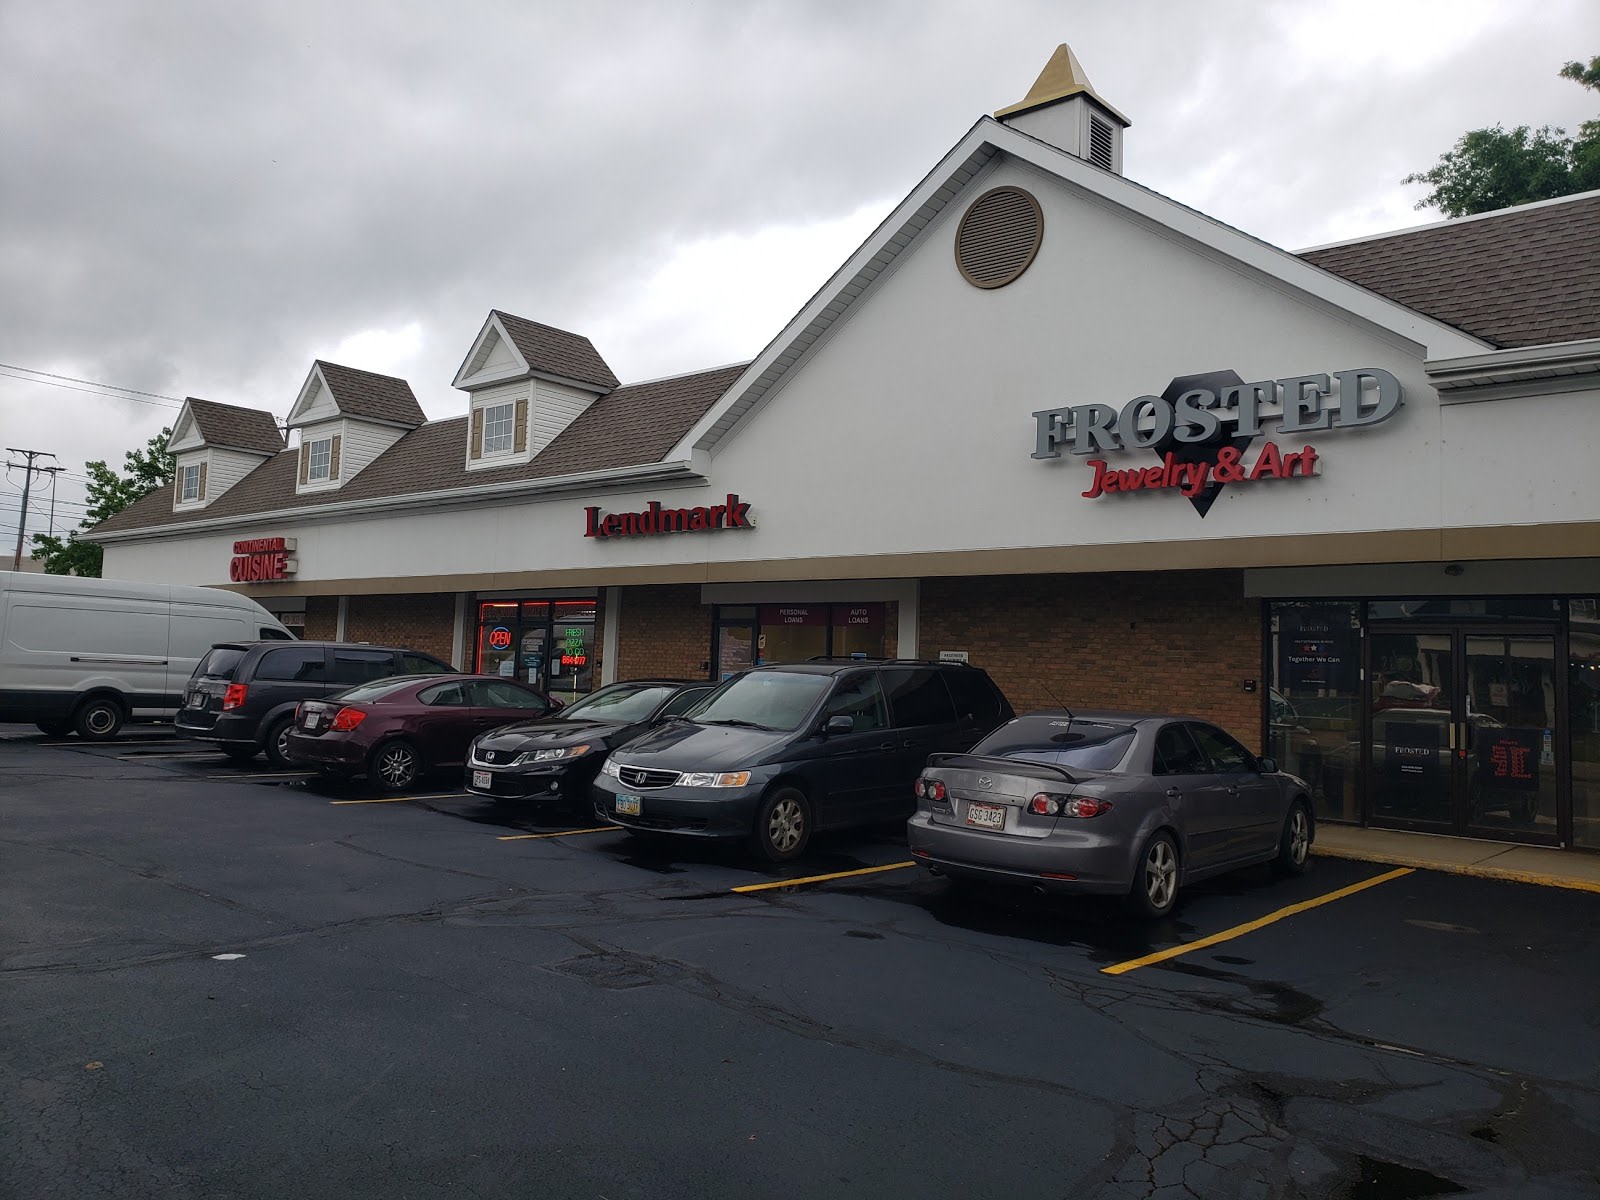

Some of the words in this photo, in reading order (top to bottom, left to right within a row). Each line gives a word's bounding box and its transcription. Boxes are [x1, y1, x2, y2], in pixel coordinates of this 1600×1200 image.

[1031, 367, 1403, 459] FROSTED
[1082, 452, 1208, 498] Jewelry
[1213, 446, 1247, 483] &
[1251, 441, 1320, 480] Art
[584, 494, 751, 537] Lendmark
[233, 537, 286, 554] CONTINENTAL
[230, 552, 288, 582] CUISINE
[848, 617, 869, 625] LOANS
[489, 631, 512, 646] OPEN
[565, 628, 584, 637] FRESH
[1395, 746, 1430, 756] FROSTED
[983, 810, 1002, 824] 3423
